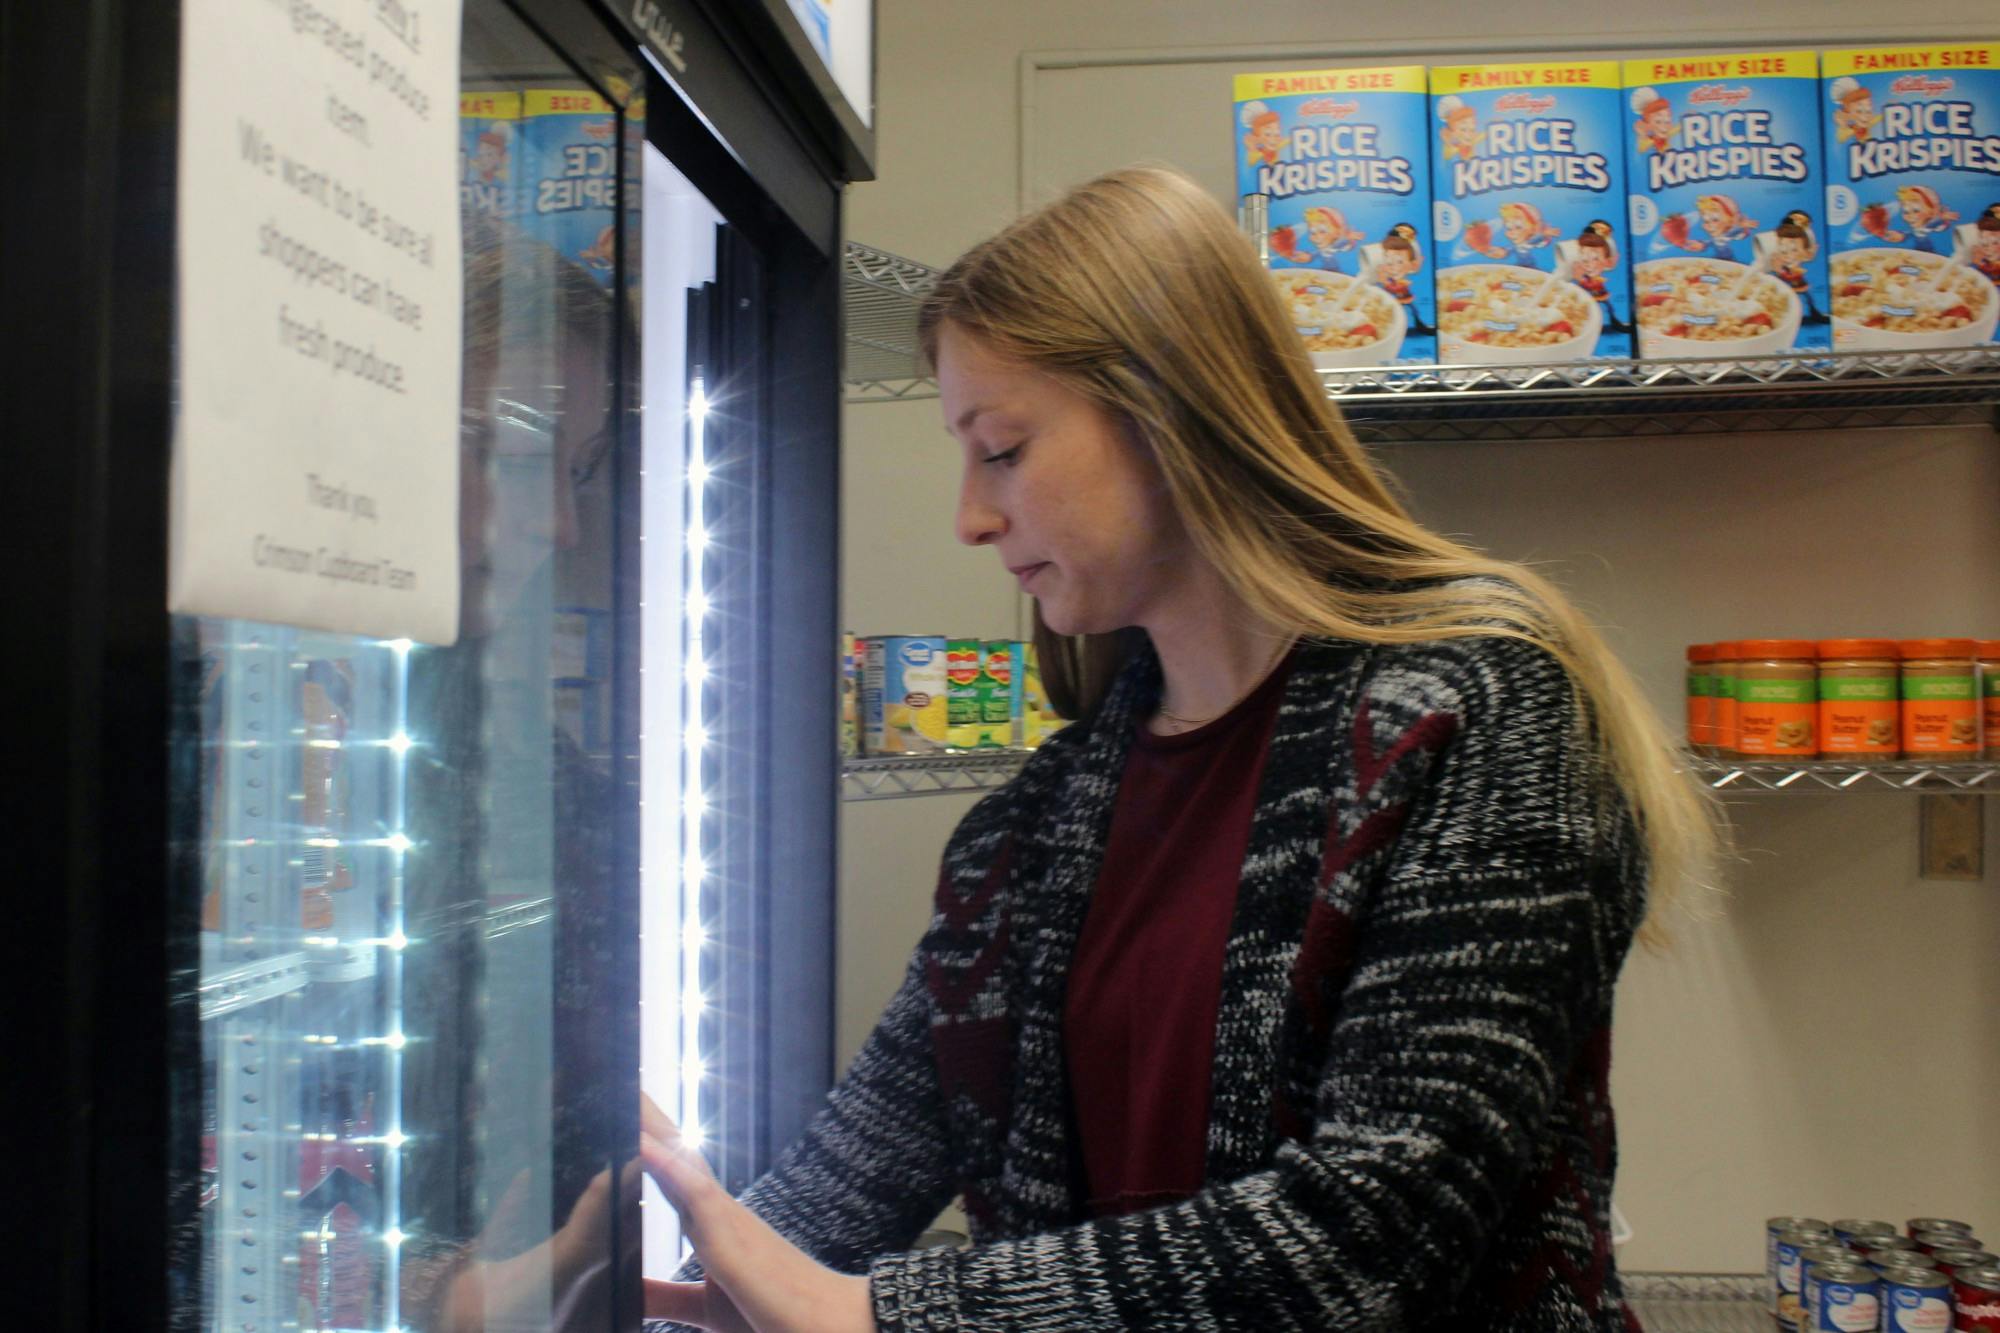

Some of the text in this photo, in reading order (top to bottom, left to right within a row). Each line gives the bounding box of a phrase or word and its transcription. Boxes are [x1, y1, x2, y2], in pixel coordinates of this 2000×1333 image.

[1653, 58, 1786, 79] FAMILY SIZE
[1854, 50, 1990, 69] FAMILY SIZE
[1263, 73, 1393, 93] FAMILY SIZE
[1459, 68, 1591, 88] FAMILY SIZE
[1488, 120, 1575, 156] RICE
[1682, 111, 1771, 148] RICE
[1885, 103, 1973, 138] RICE
[1293, 124, 1377, 160] RICE
[1850, 136, 2000, 181] KRISPIES
[1259, 158, 1414, 197] KRISPIES
[1454, 154, 1610, 197] KRISPIES
[1649, 145, 1807, 191] KRISPIES
[278, 304, 329, 362] fresh
